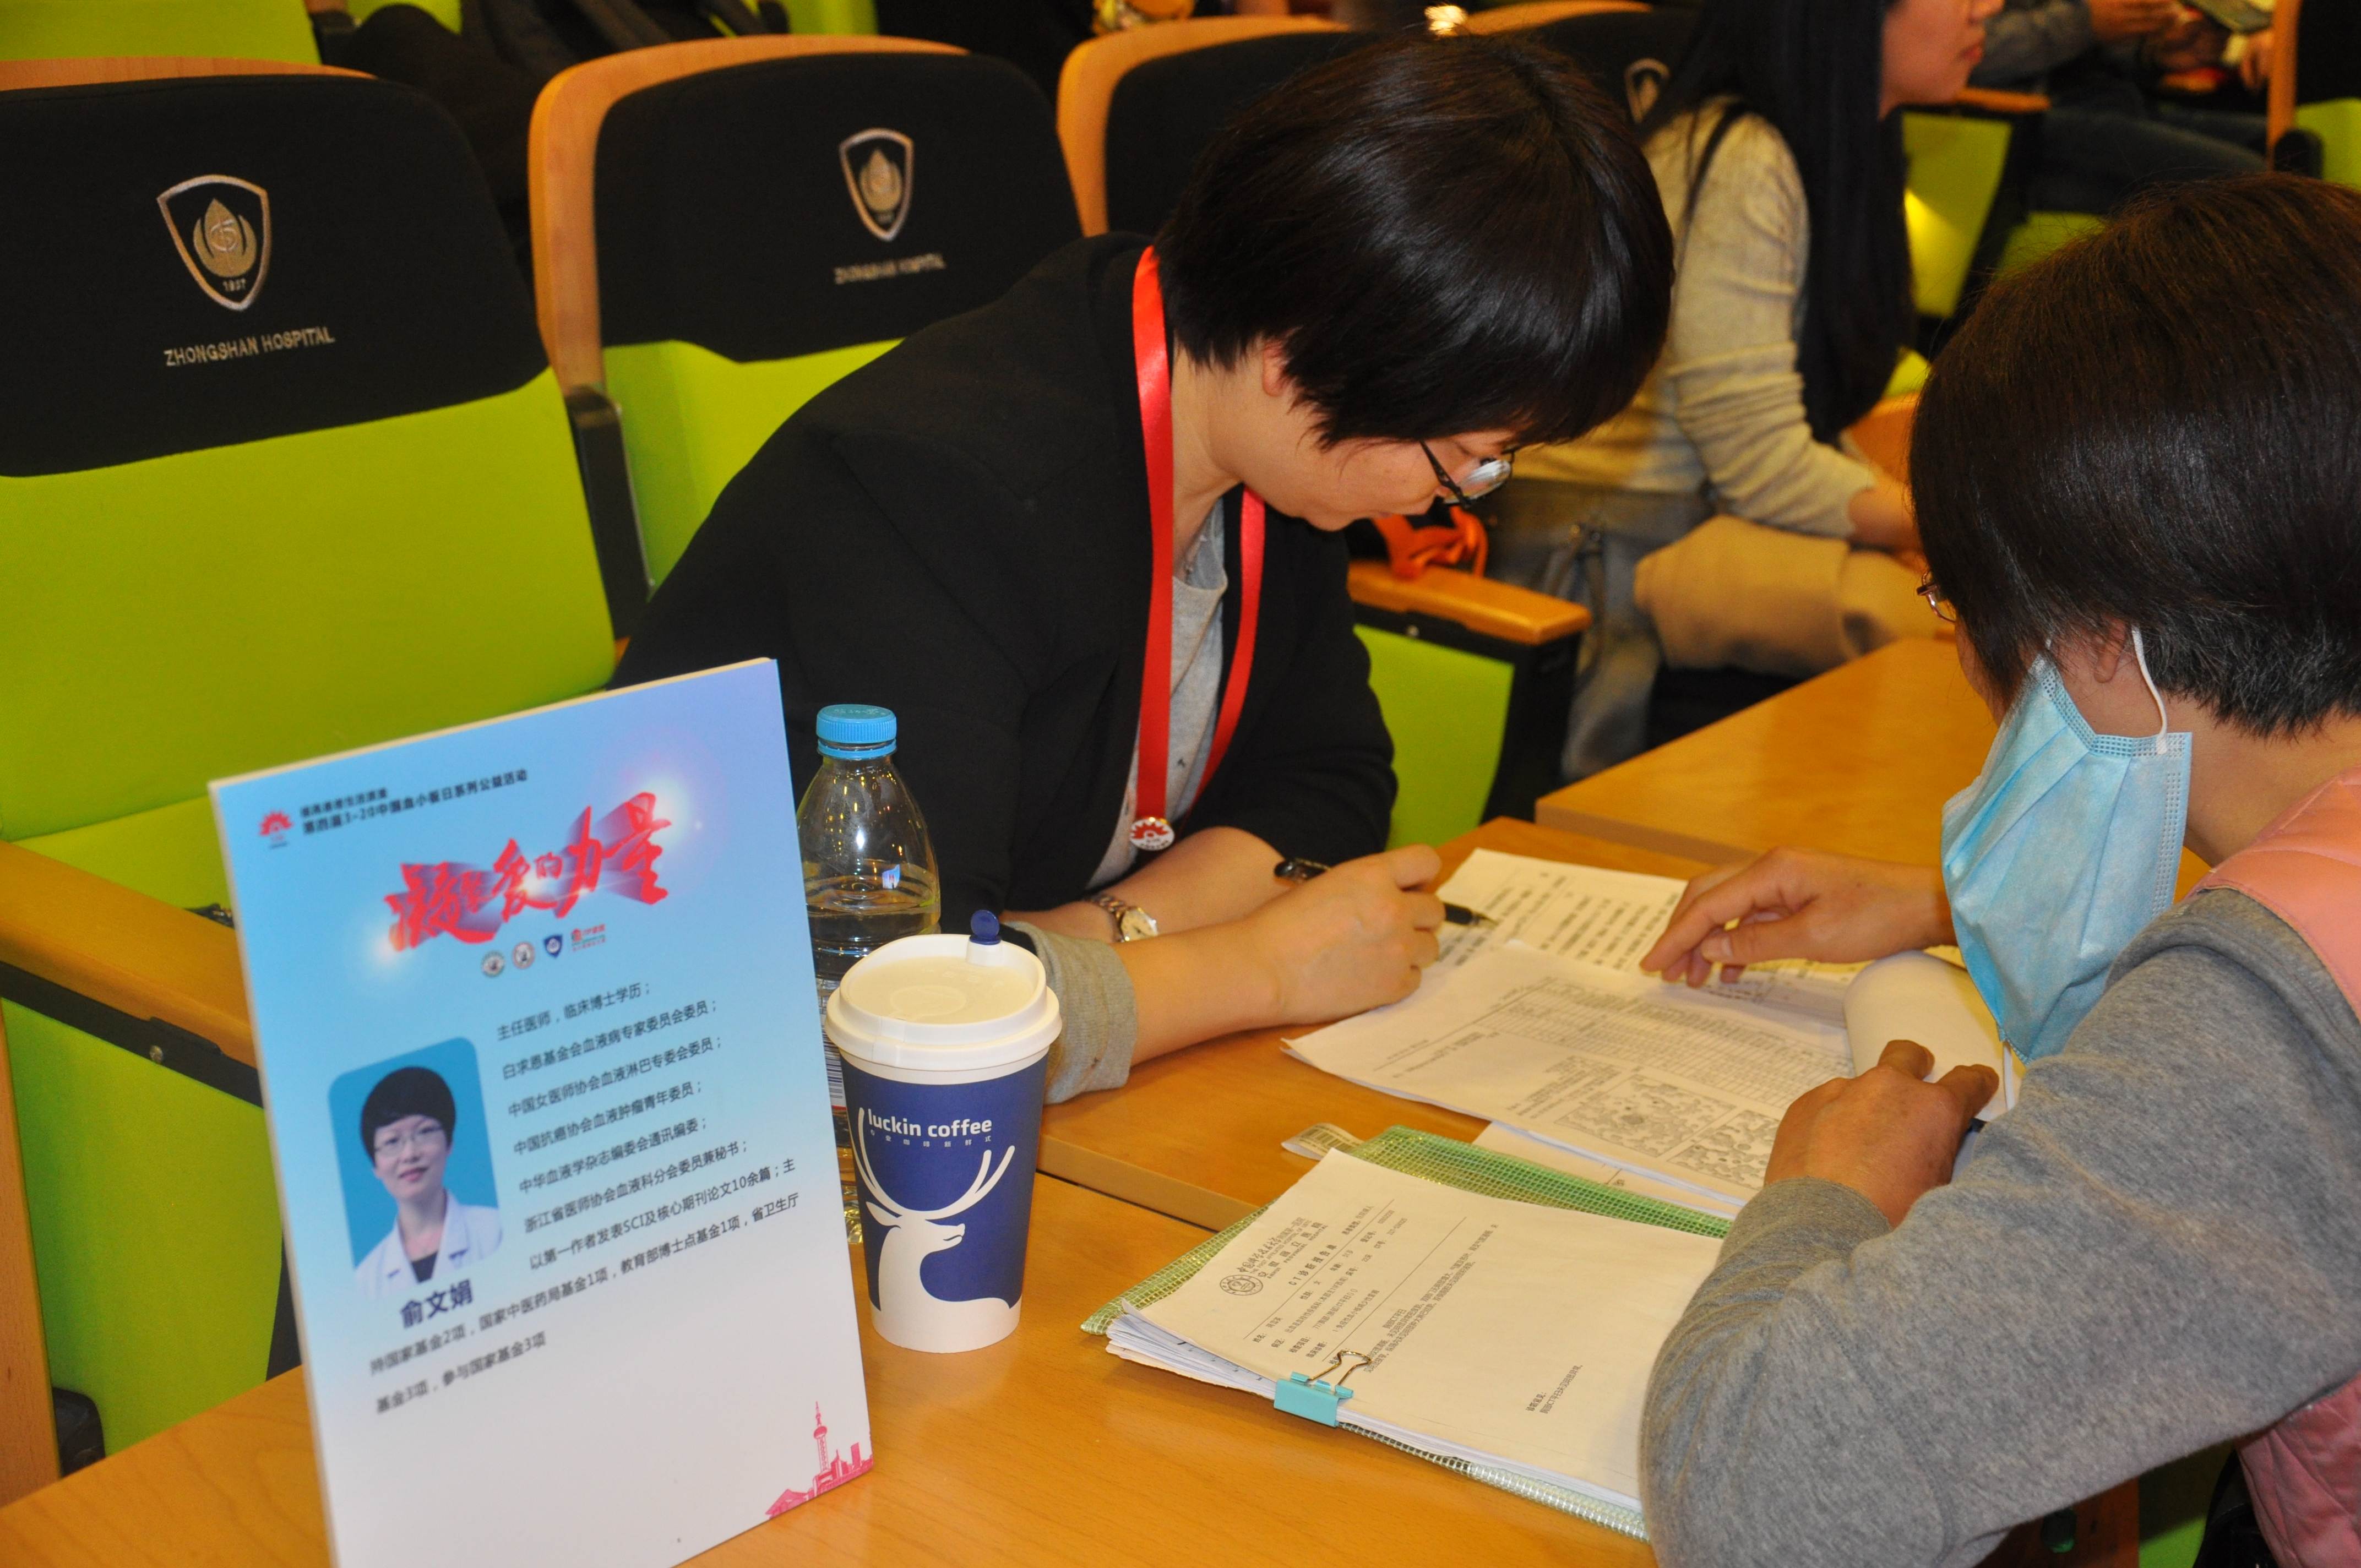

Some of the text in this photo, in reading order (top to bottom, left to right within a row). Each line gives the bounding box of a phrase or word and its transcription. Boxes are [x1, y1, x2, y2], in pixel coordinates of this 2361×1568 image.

[164, 327, 335, 366] ZHONGSHAN HOSPITAL
[868, 1108, 992, 1137] luckin coffee
[400, 1279, 473, 1329] 俞文娟
